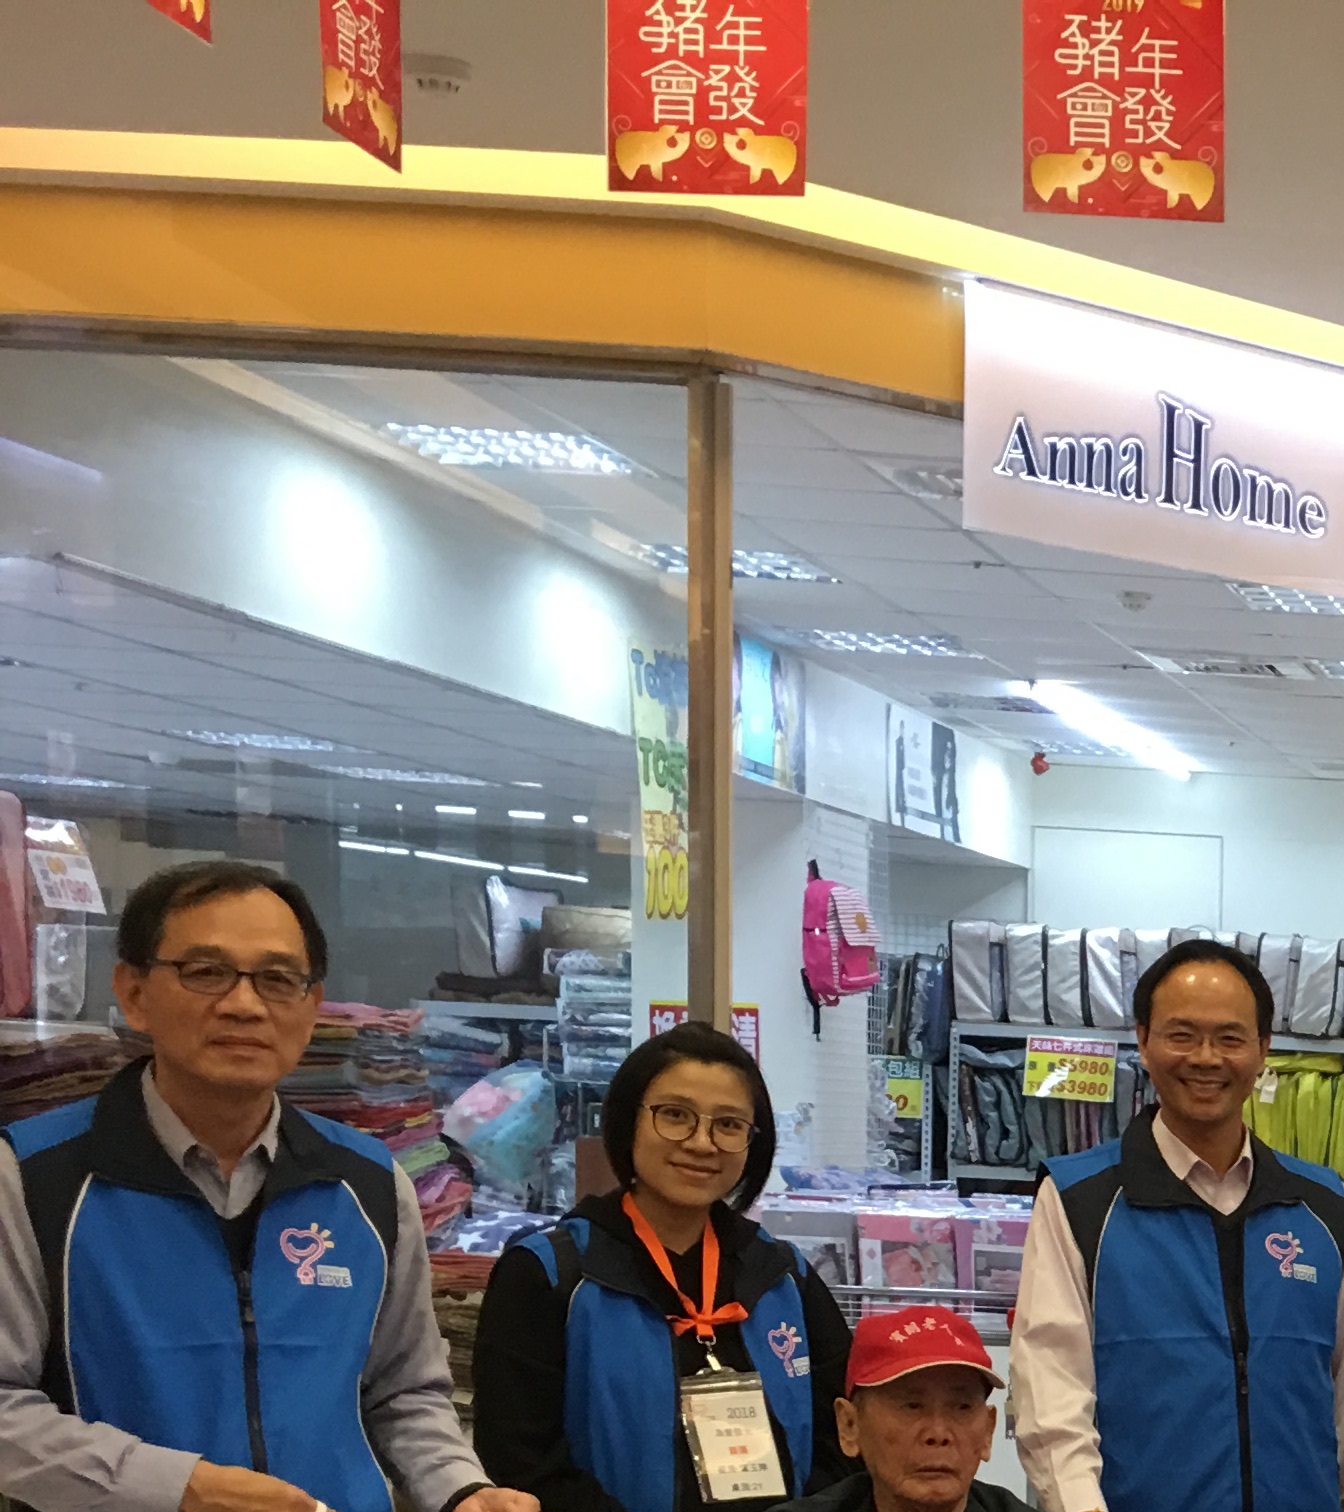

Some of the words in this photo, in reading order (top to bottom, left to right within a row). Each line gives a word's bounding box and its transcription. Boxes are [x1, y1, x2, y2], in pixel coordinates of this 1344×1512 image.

[1054, 13, 1183, 90] 豬年
[641, 60, 766, 126] 會發
[1056, 81, 1182, 149] 會發
[725, 1406, 758, 1420] 2018
